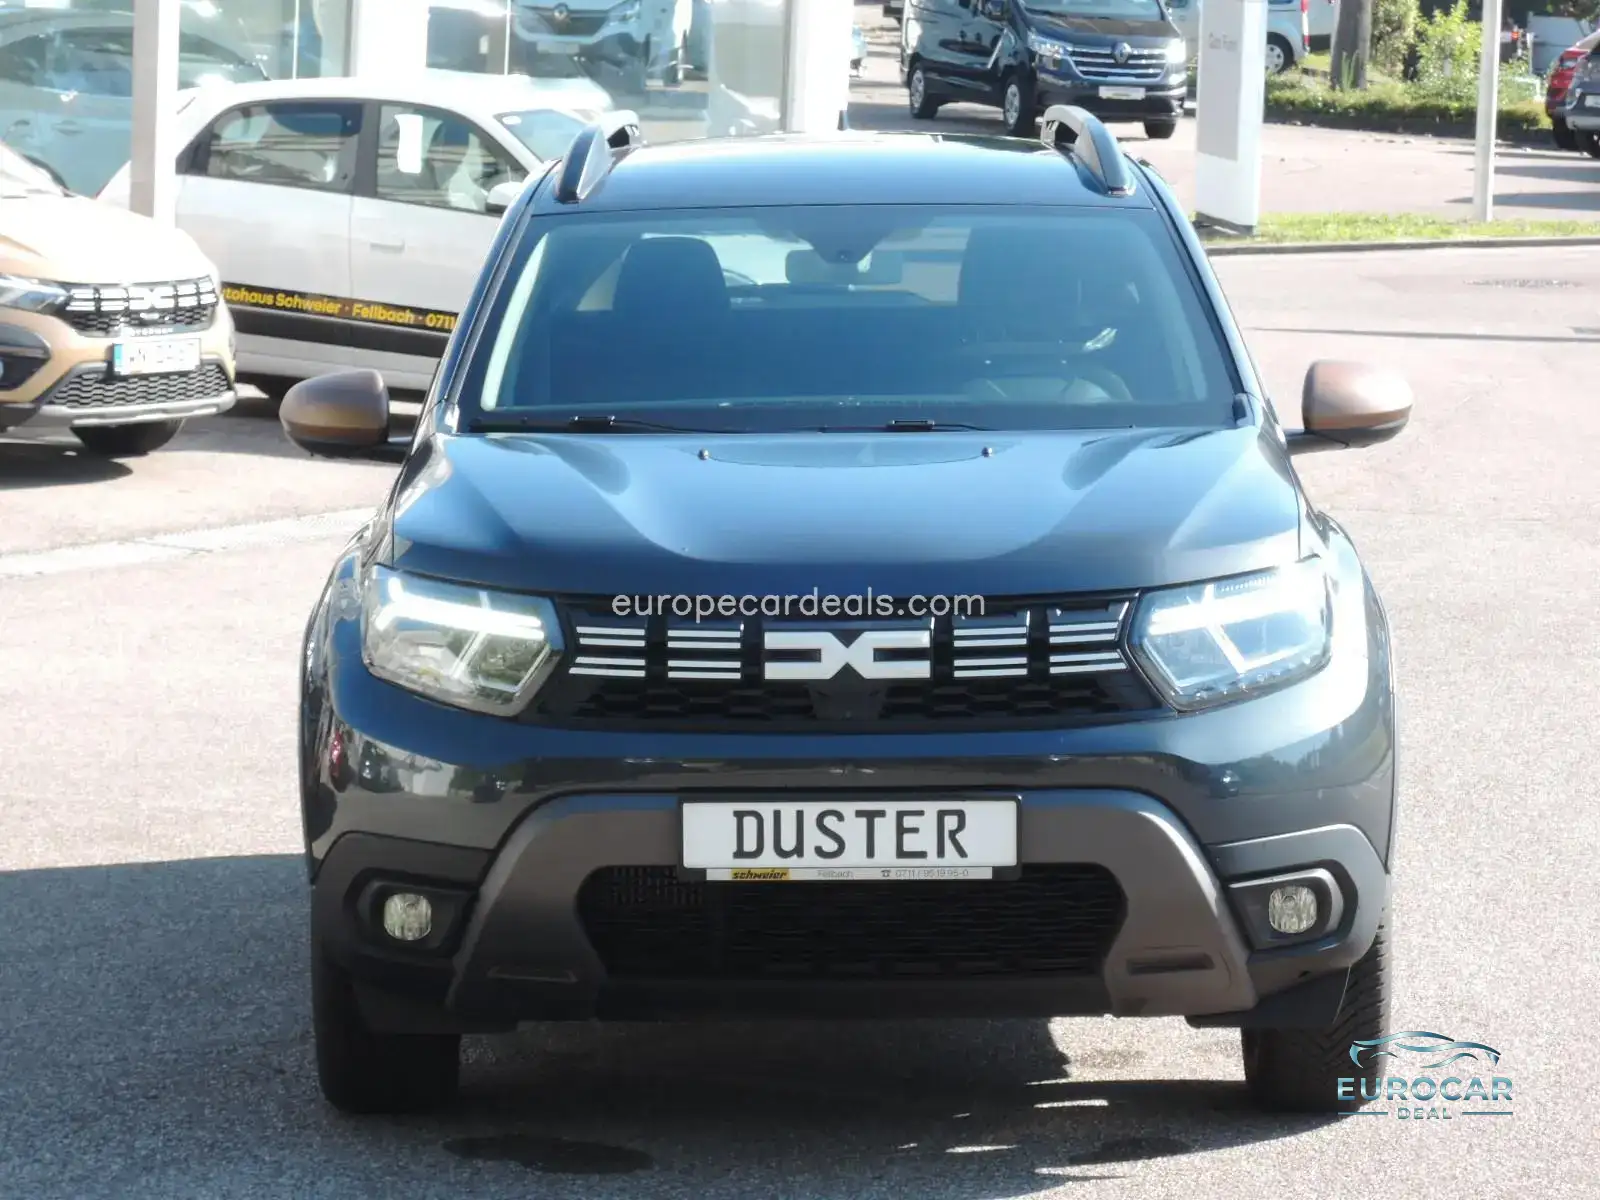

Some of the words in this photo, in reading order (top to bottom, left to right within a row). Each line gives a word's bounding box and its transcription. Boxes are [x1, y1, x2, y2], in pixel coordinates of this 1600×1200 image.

[275, 292, 342, 314] Schweier
[352, 302, 416, 325] Fellbach
[732, 809, 968, 860] DUSTER
